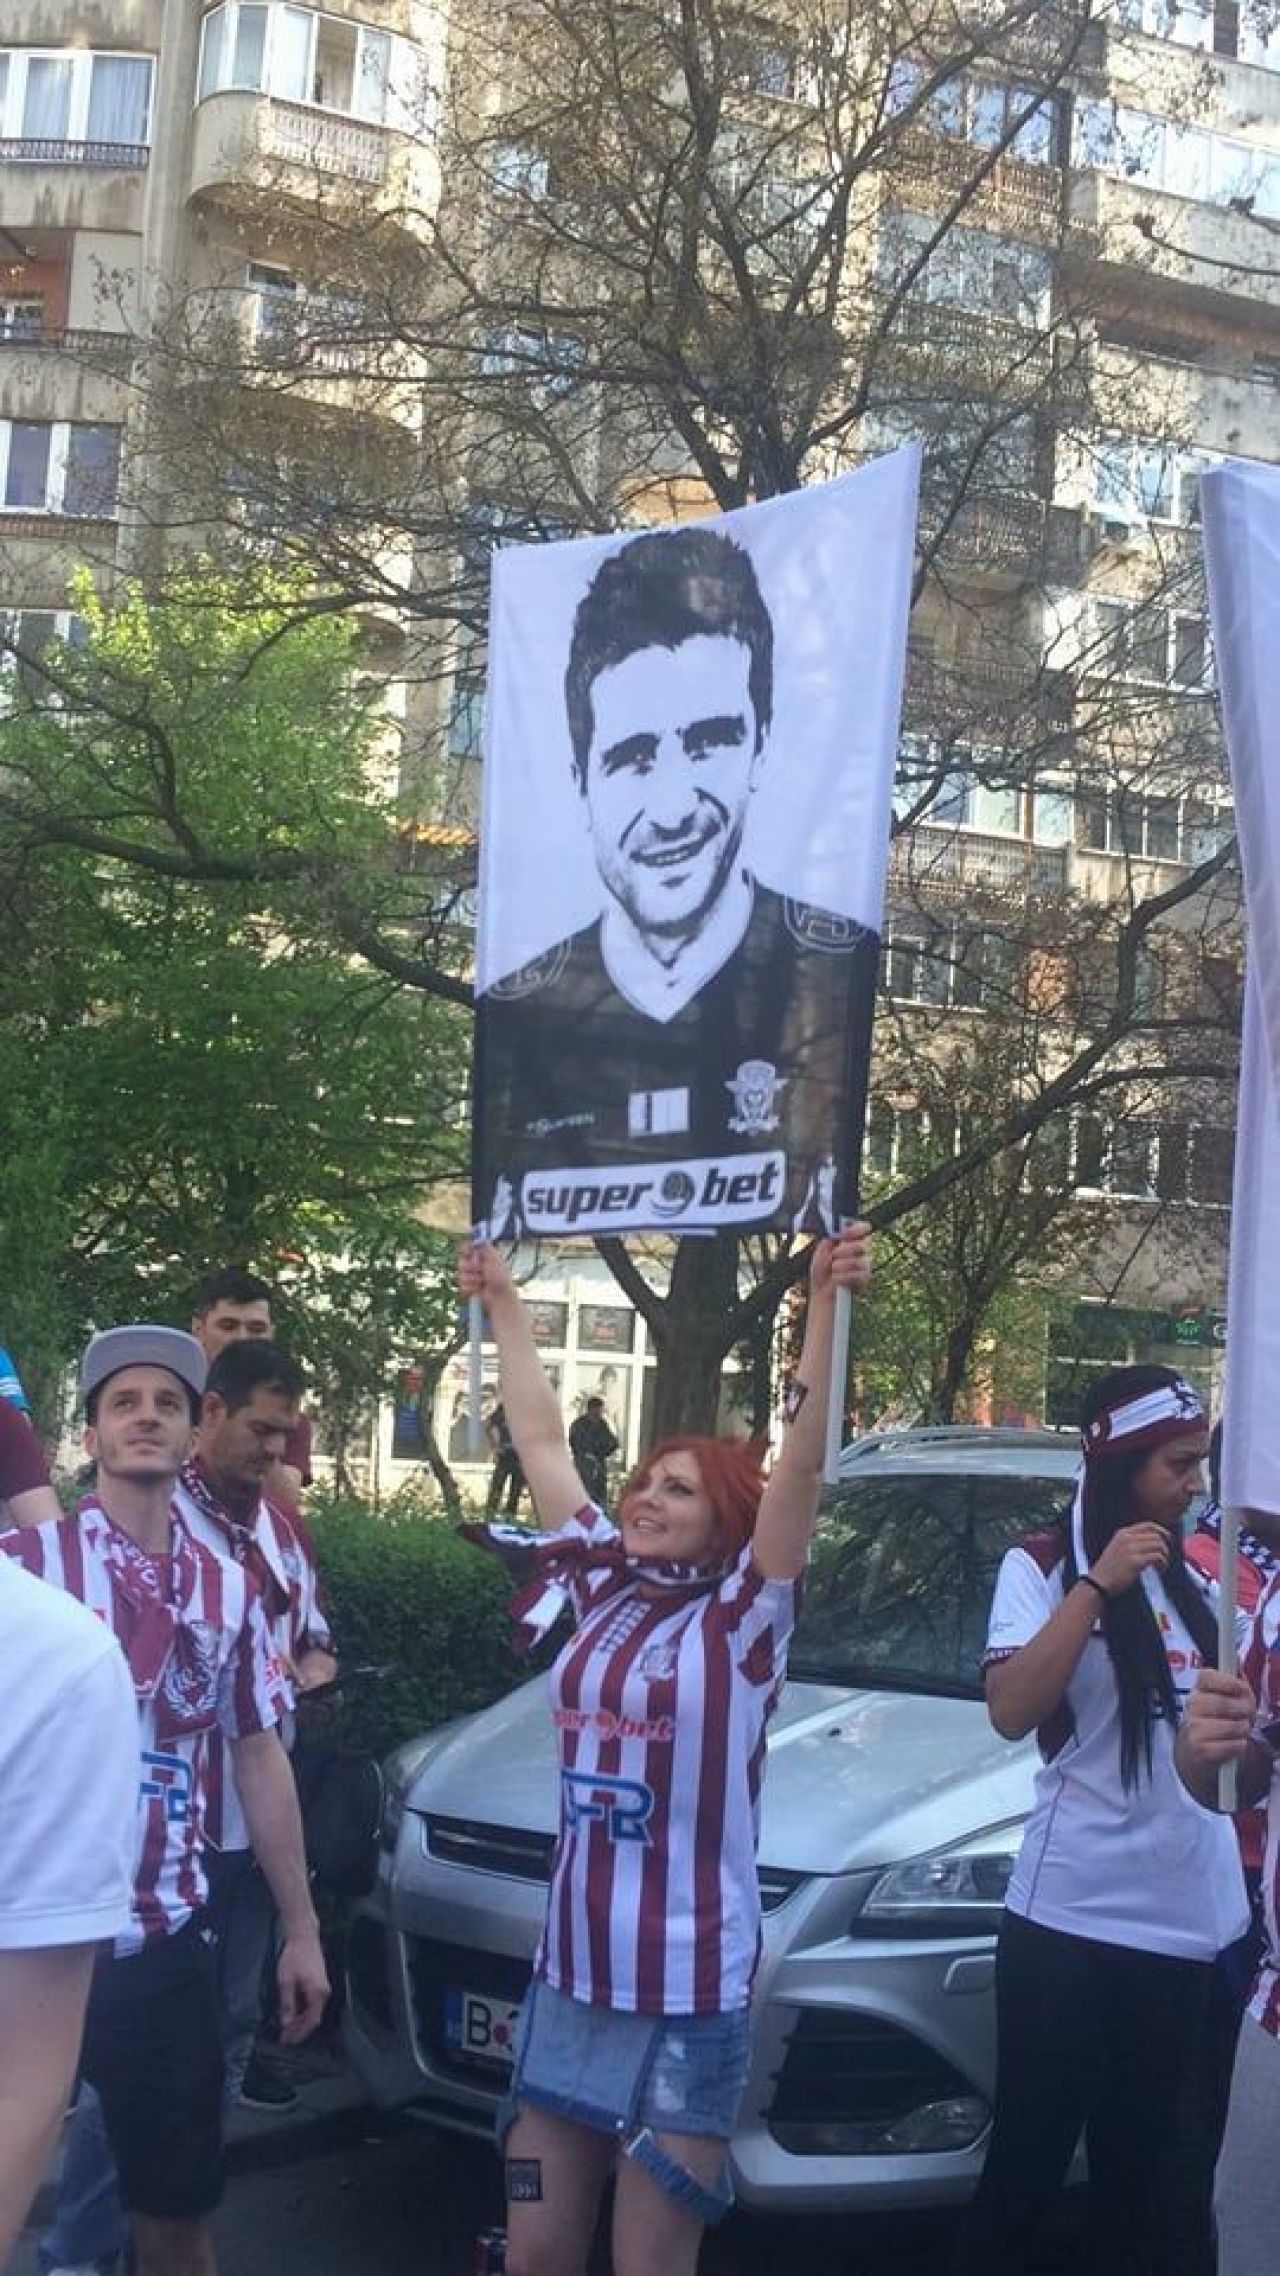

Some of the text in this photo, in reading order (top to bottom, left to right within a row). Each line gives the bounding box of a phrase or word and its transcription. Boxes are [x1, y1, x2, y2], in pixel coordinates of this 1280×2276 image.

[527, 1161, 779, 1223] super bet
[467, 2000, 491, 2047] B
